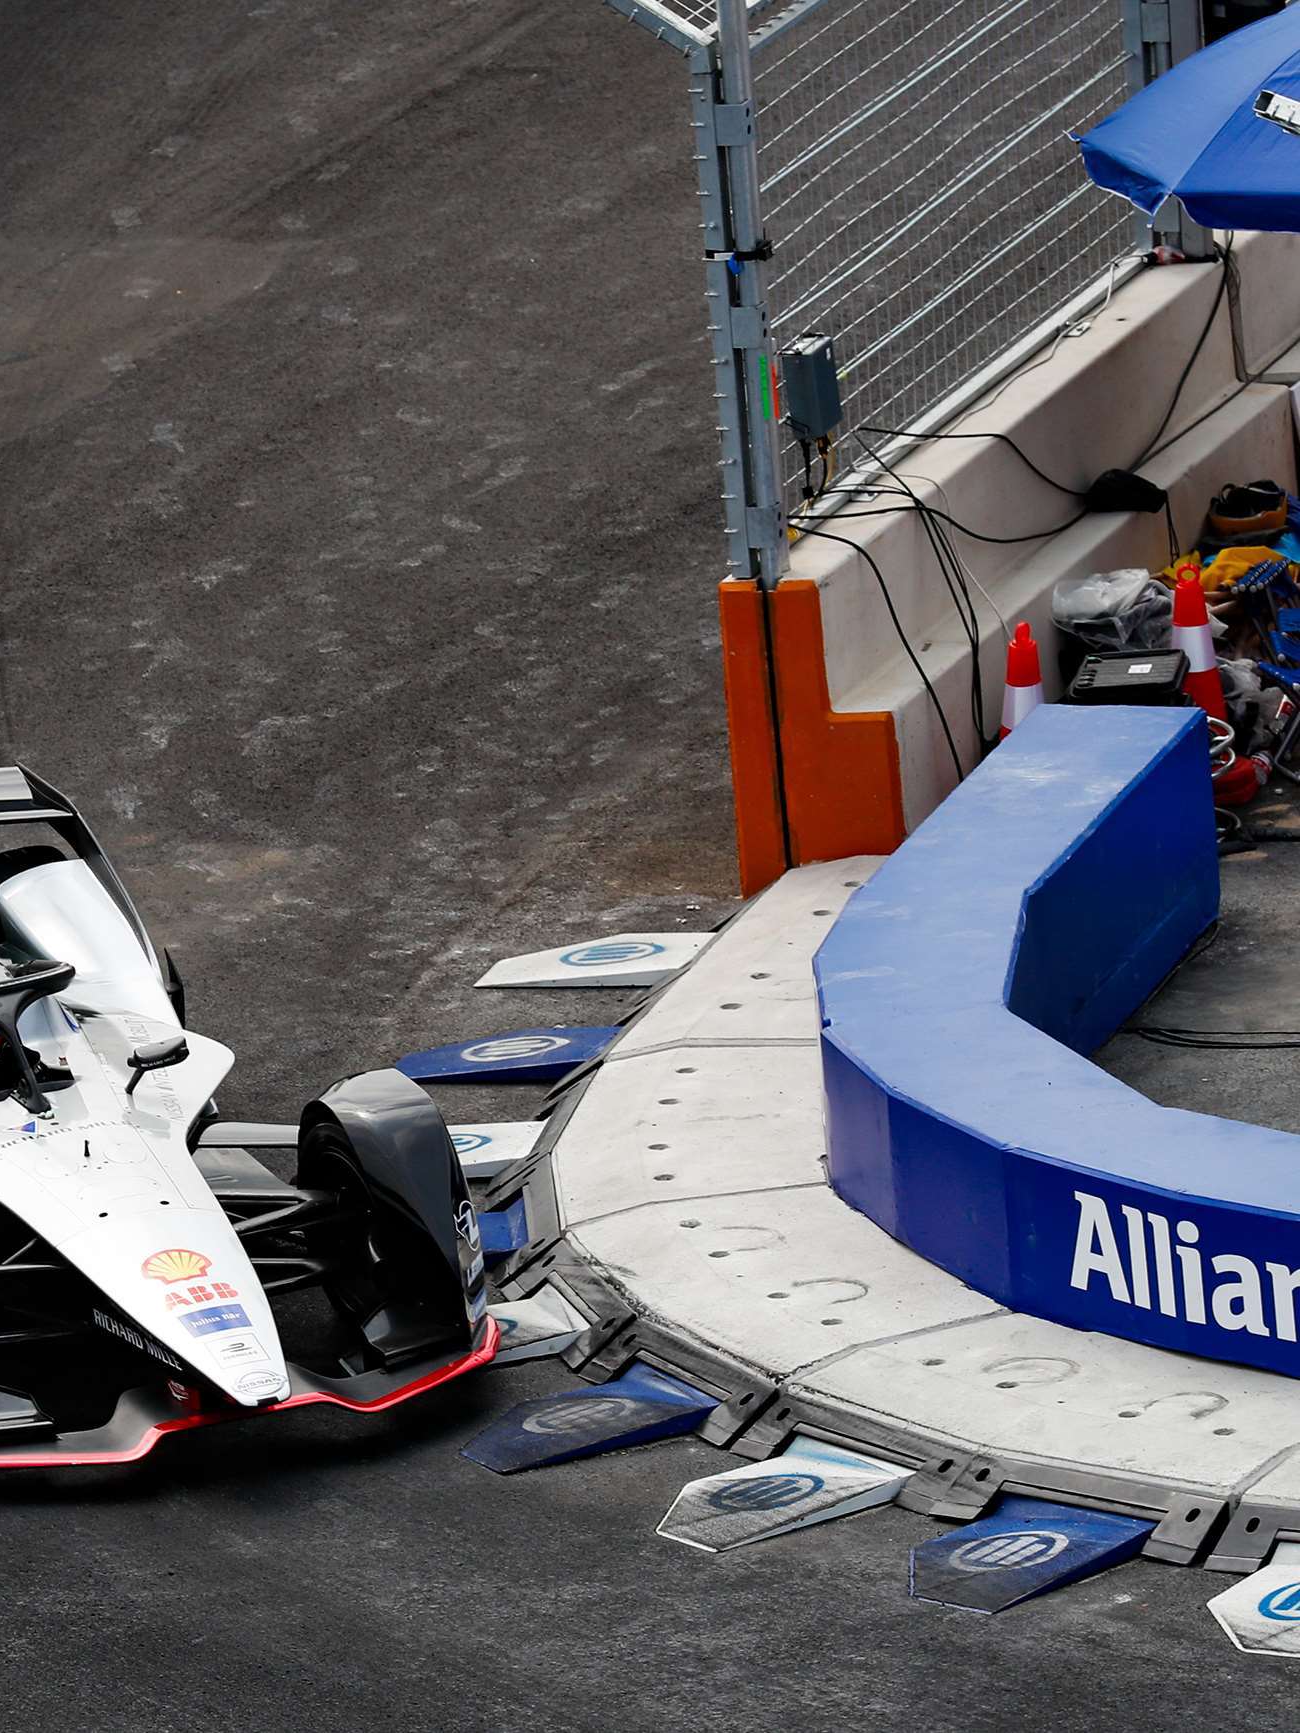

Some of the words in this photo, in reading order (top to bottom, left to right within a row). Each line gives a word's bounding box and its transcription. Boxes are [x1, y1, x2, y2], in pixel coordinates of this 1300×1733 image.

[164, 1282, 239, 1312] ABB
[93, 1307, 144, 1349] RICHARD
[144, 1337, 183, 1371] MILLE
